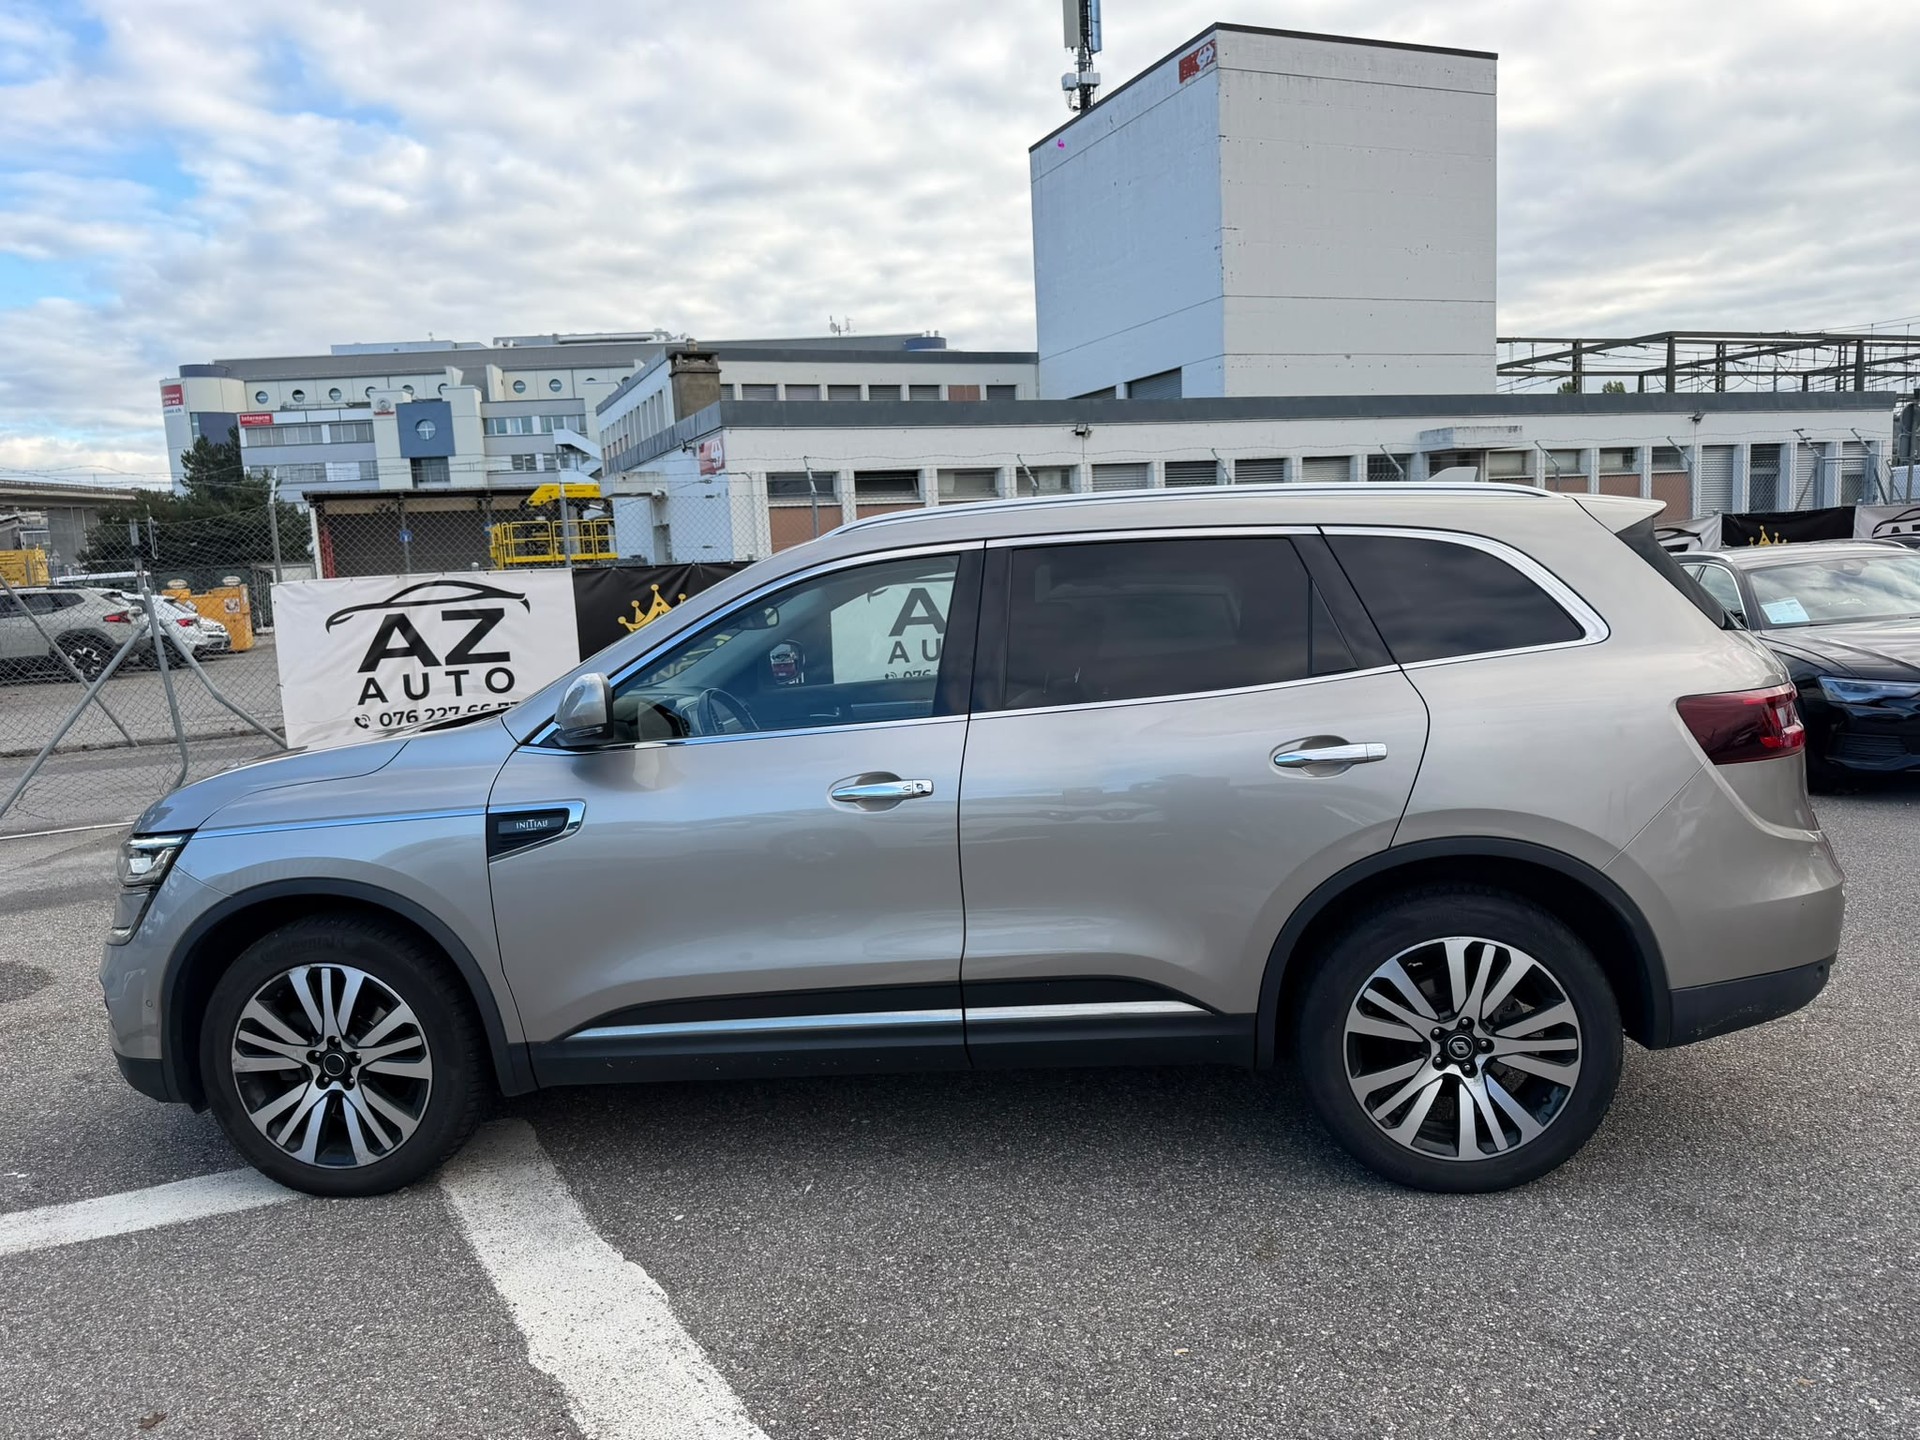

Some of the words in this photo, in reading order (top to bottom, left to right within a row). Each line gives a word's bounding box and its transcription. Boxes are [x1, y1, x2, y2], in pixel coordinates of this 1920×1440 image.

[357, 608, 511, 673] AZ
[357, 667, 515, 705] AUTO
[379, 709, 419, 727] 076
